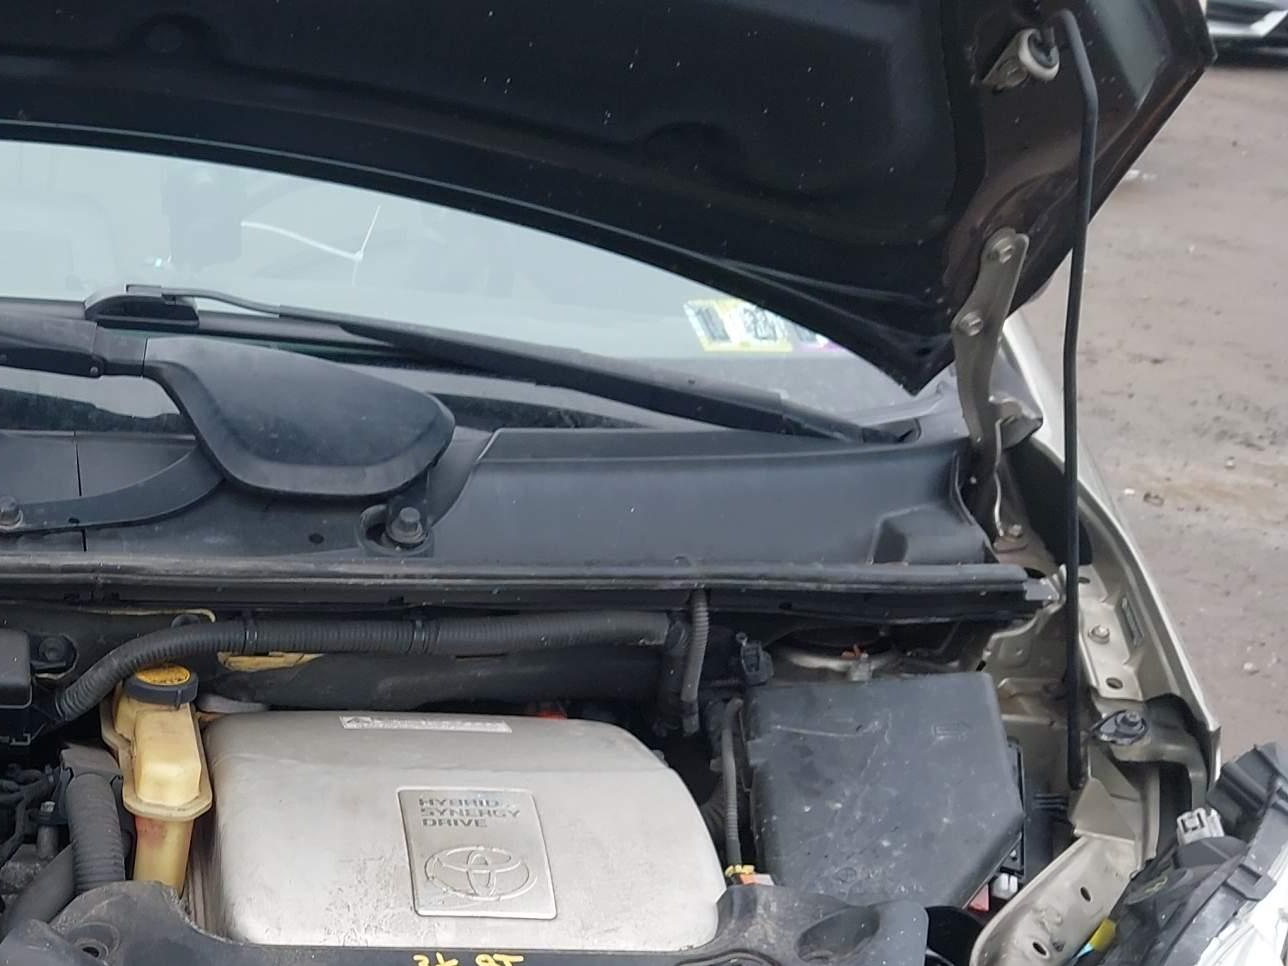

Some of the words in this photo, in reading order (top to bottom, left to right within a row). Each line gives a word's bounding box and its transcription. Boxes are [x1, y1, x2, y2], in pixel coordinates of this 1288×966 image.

[418, 798, 500, 807] HYBRID
[420, 807, 521, 818] SYNERGY
[422, 818, 489, 828] DRIVE
